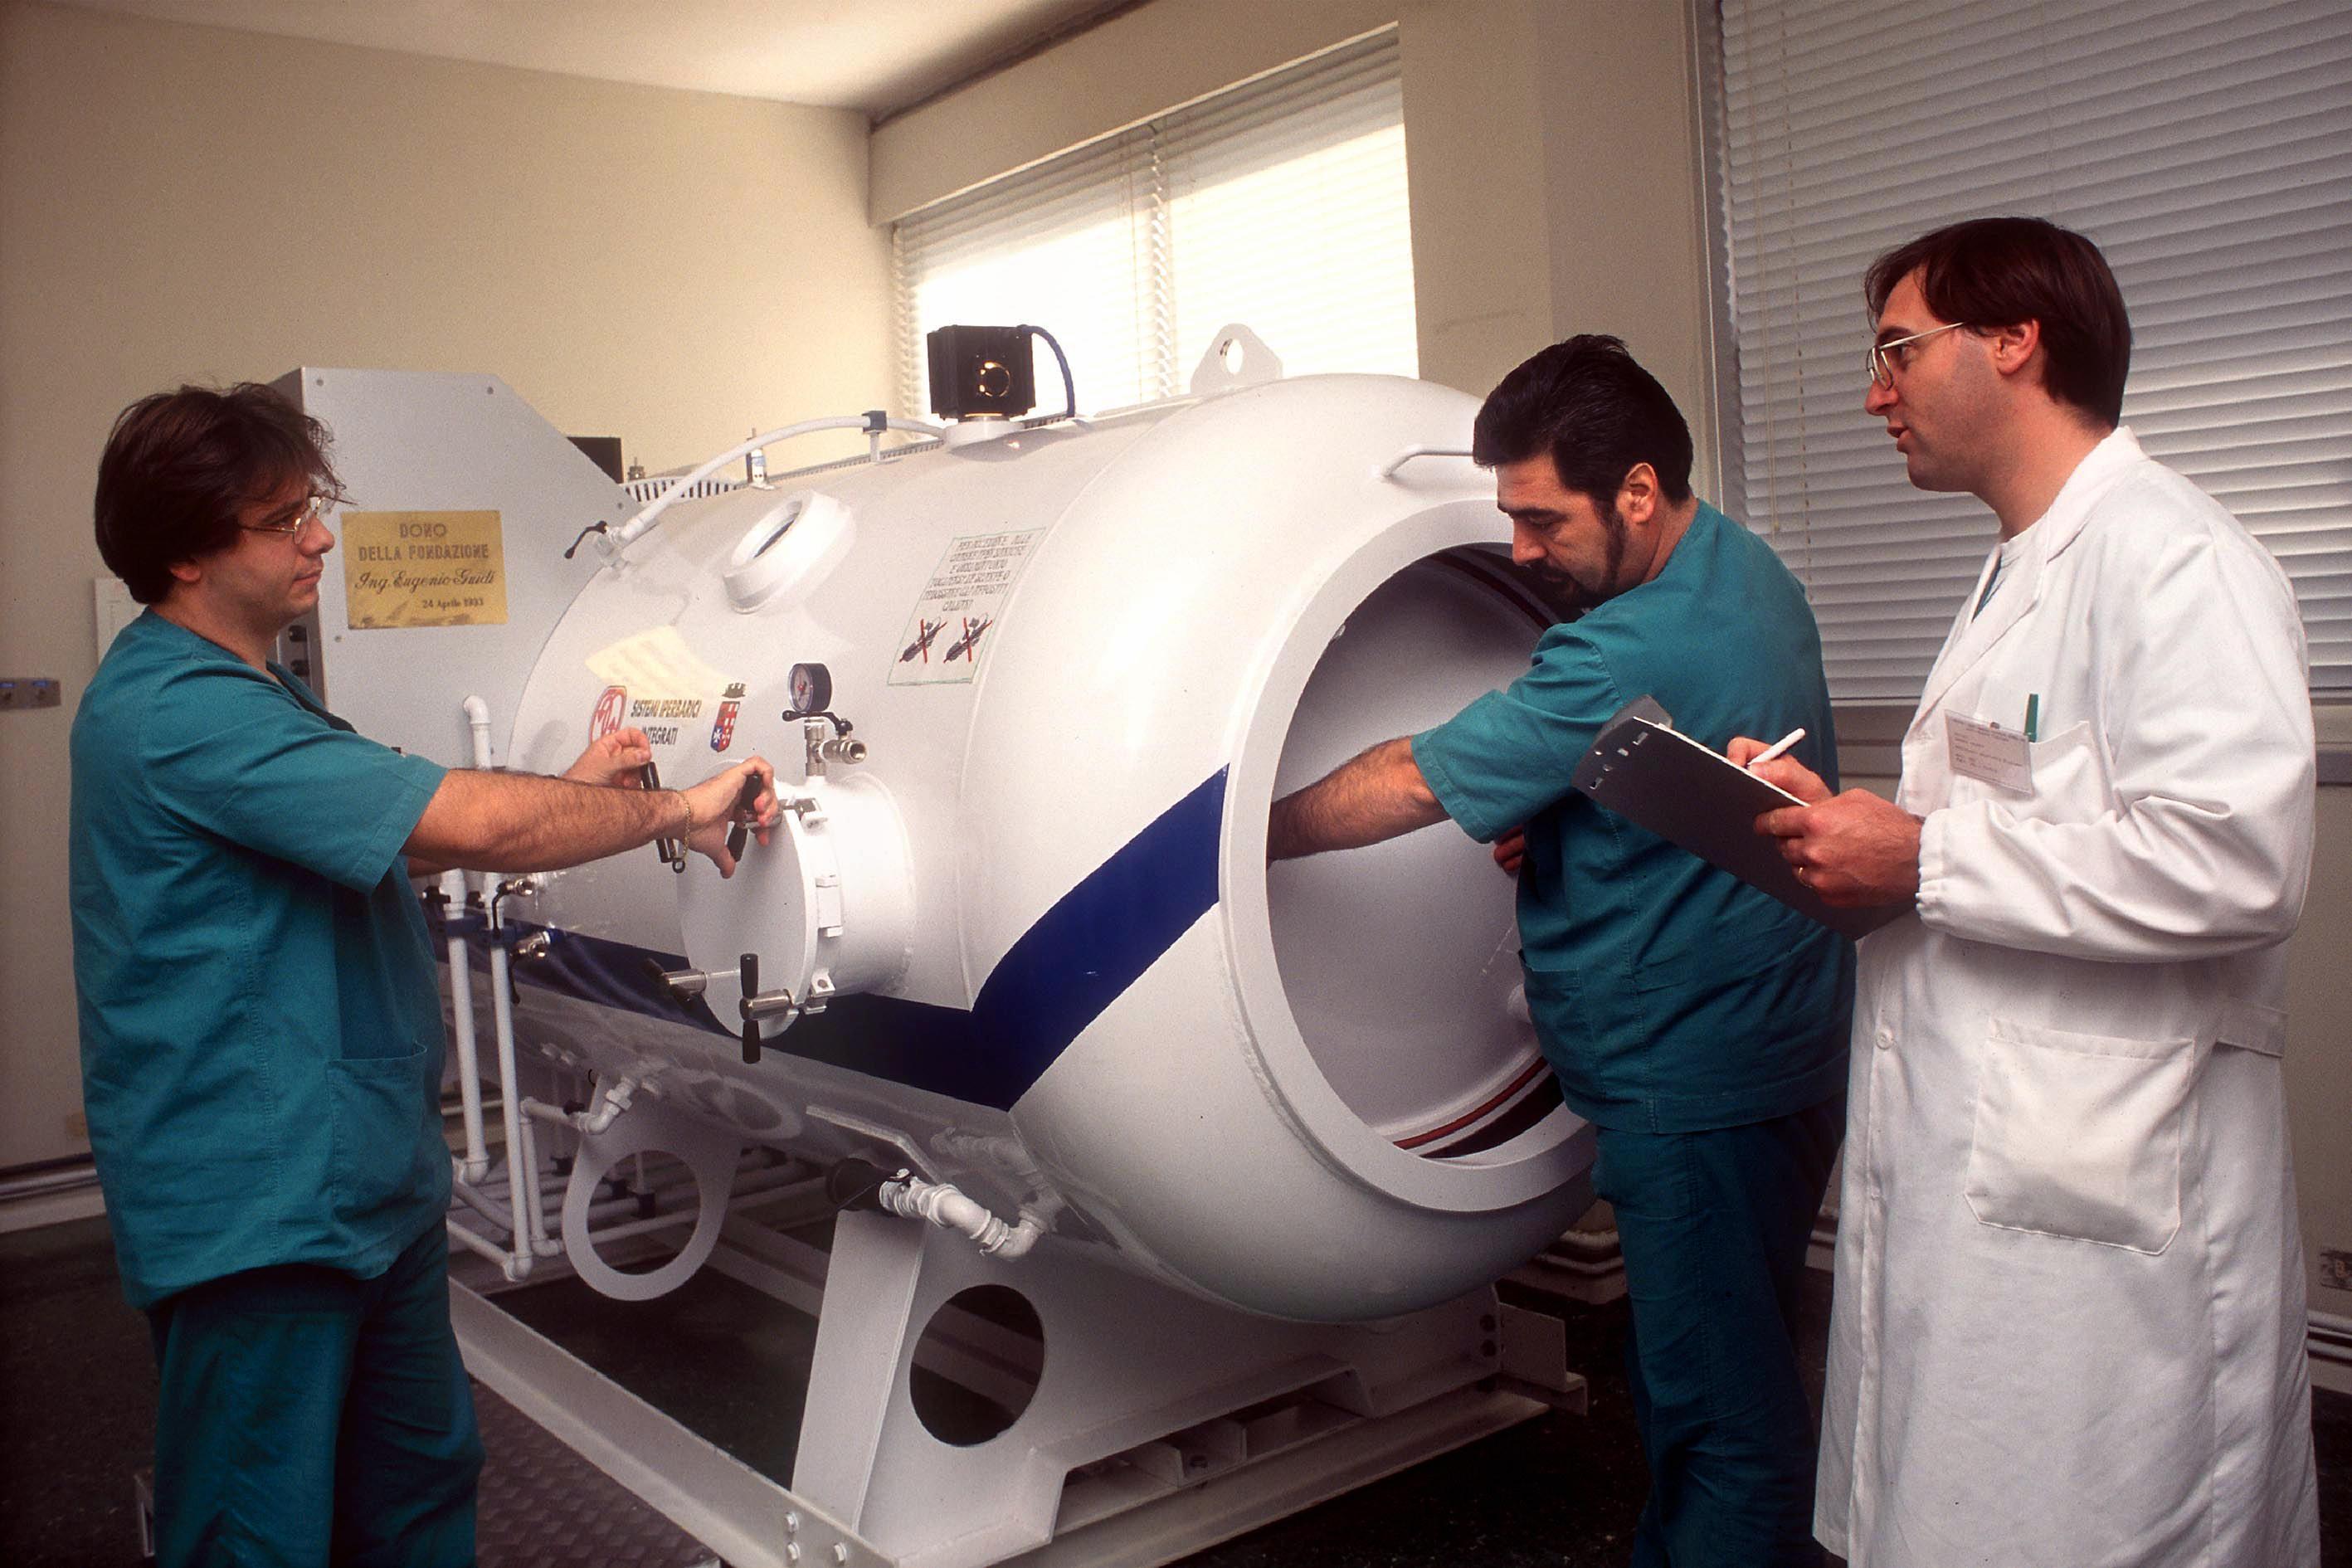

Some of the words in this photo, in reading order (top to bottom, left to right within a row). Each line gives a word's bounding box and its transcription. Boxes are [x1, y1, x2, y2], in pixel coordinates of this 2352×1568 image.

[399, 523, 446, 538] DONO
[358, 546, 402, 562] DELLA
[409, 543, 489, 560] FONDAZIONE
